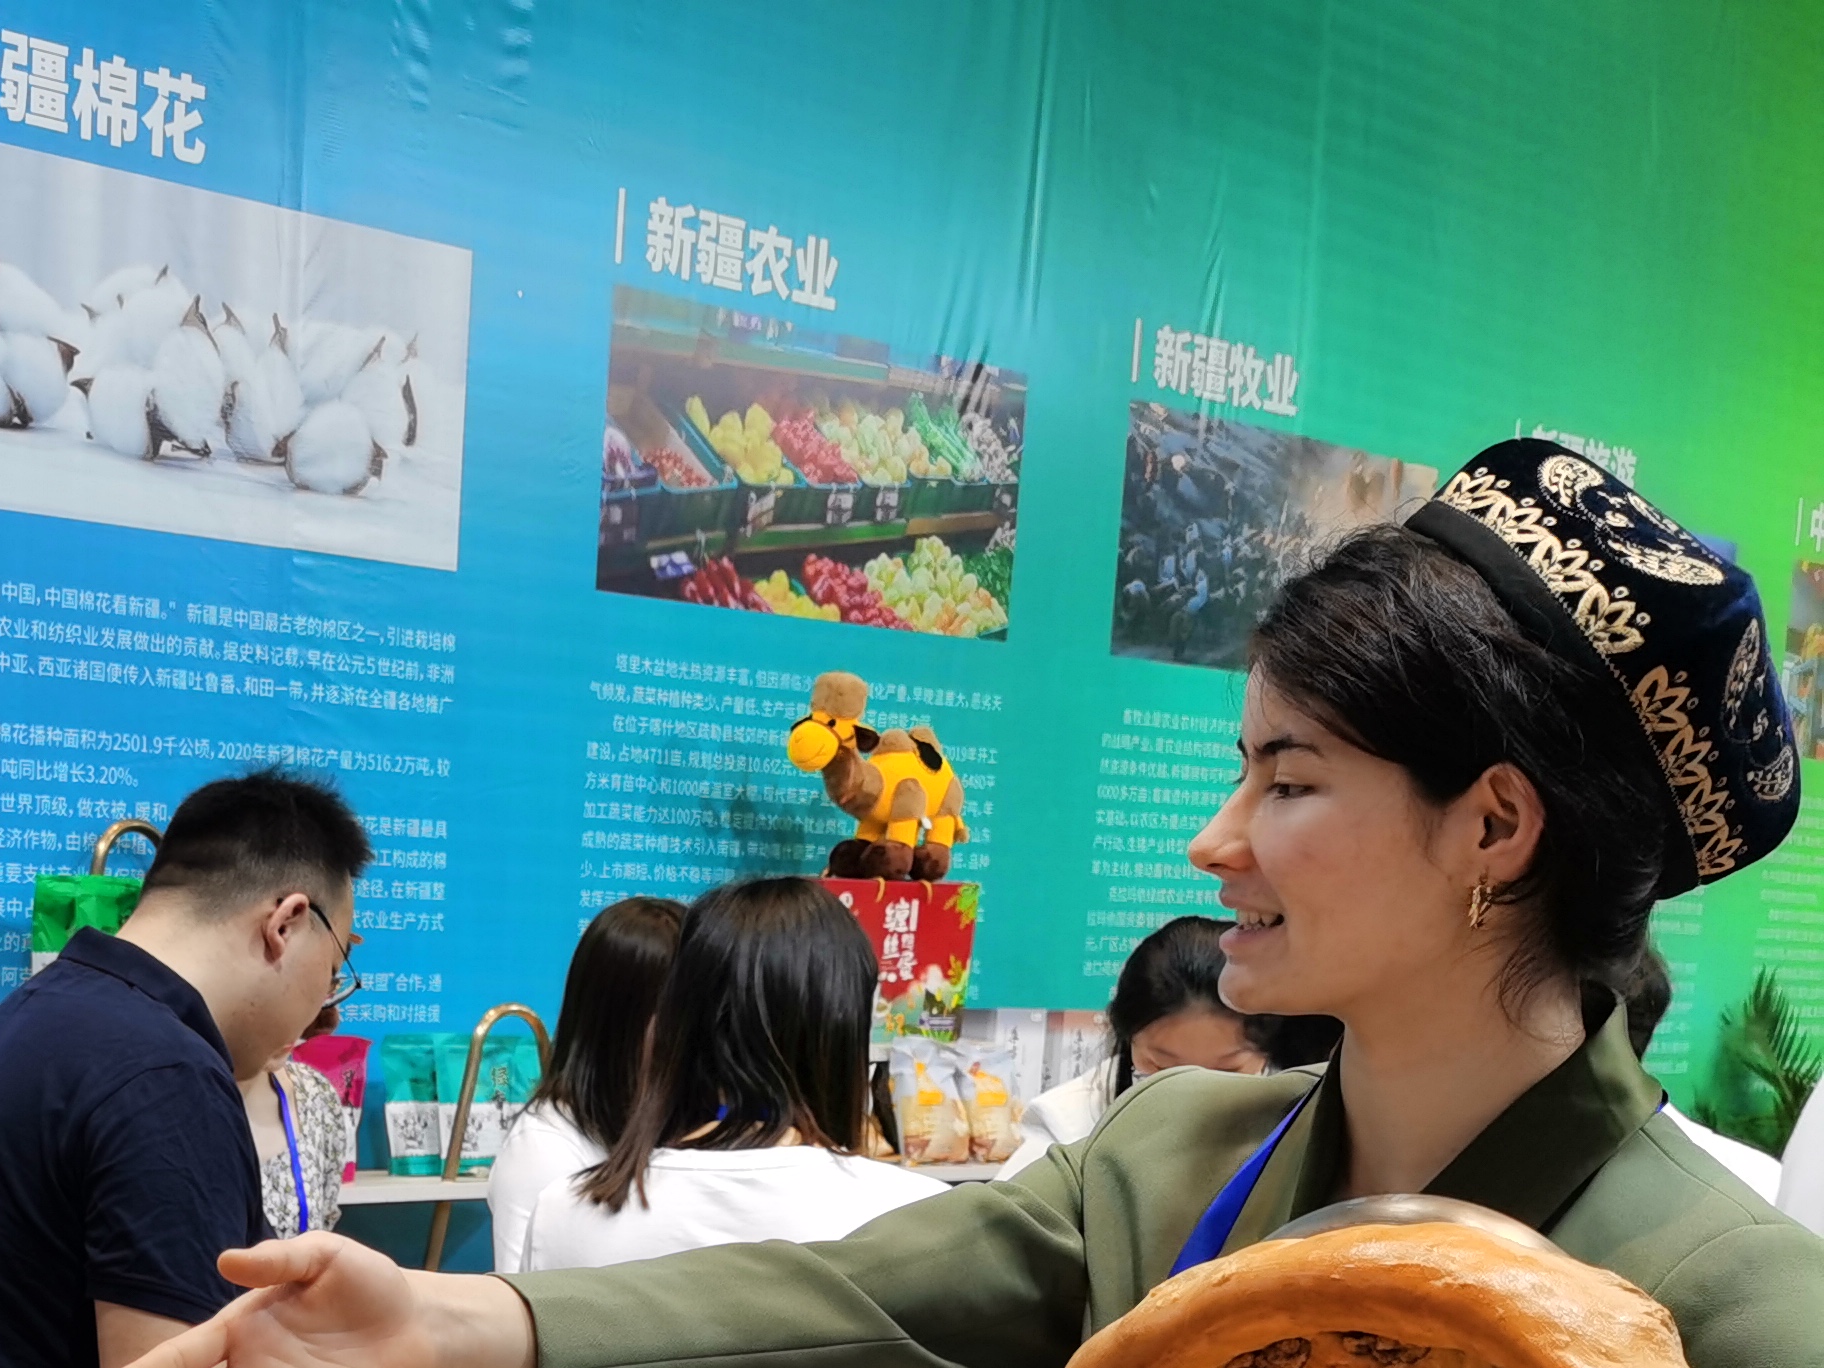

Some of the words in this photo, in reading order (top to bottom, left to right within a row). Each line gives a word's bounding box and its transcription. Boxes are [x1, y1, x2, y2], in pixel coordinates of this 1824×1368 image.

[646, 196, 838, 311] 新疆农业
[1153, 324, 1299, 417] 新疆牧业
